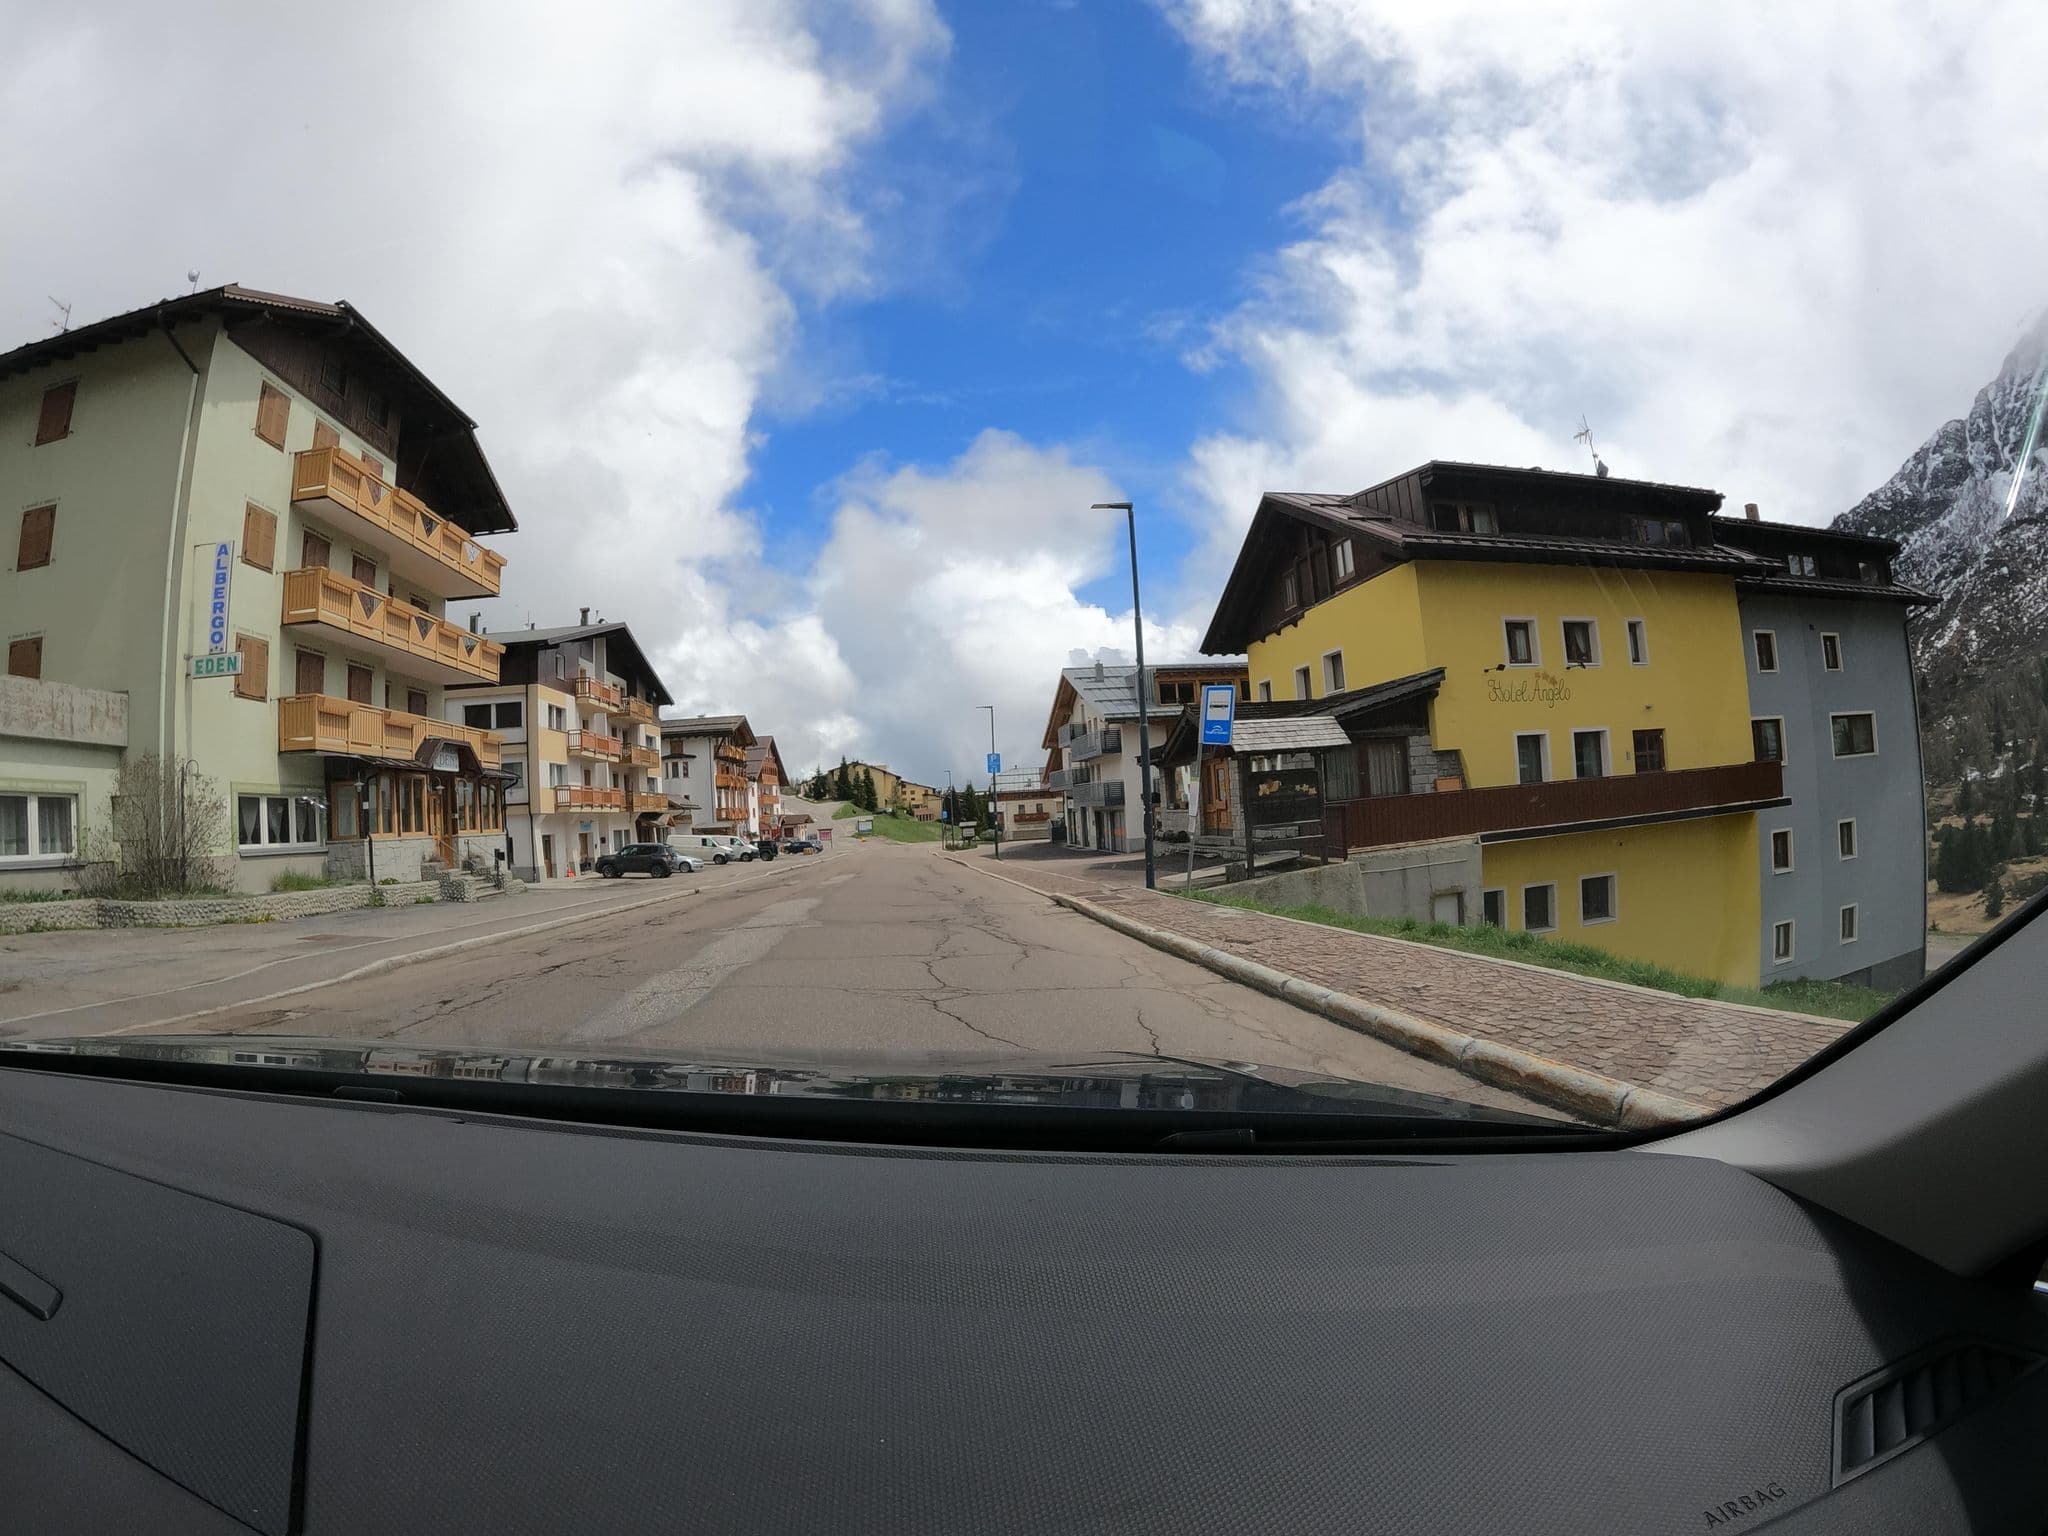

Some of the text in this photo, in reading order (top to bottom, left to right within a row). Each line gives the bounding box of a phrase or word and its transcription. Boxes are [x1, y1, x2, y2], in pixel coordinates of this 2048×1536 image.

[211, 543, 229, 645] ALBERGO
[195, 656, 237, 675] EDEN
[1488, 678, 1570, 708] Hotel Angelo
[1703, 1482, 1787, 1530] AIRBAG
